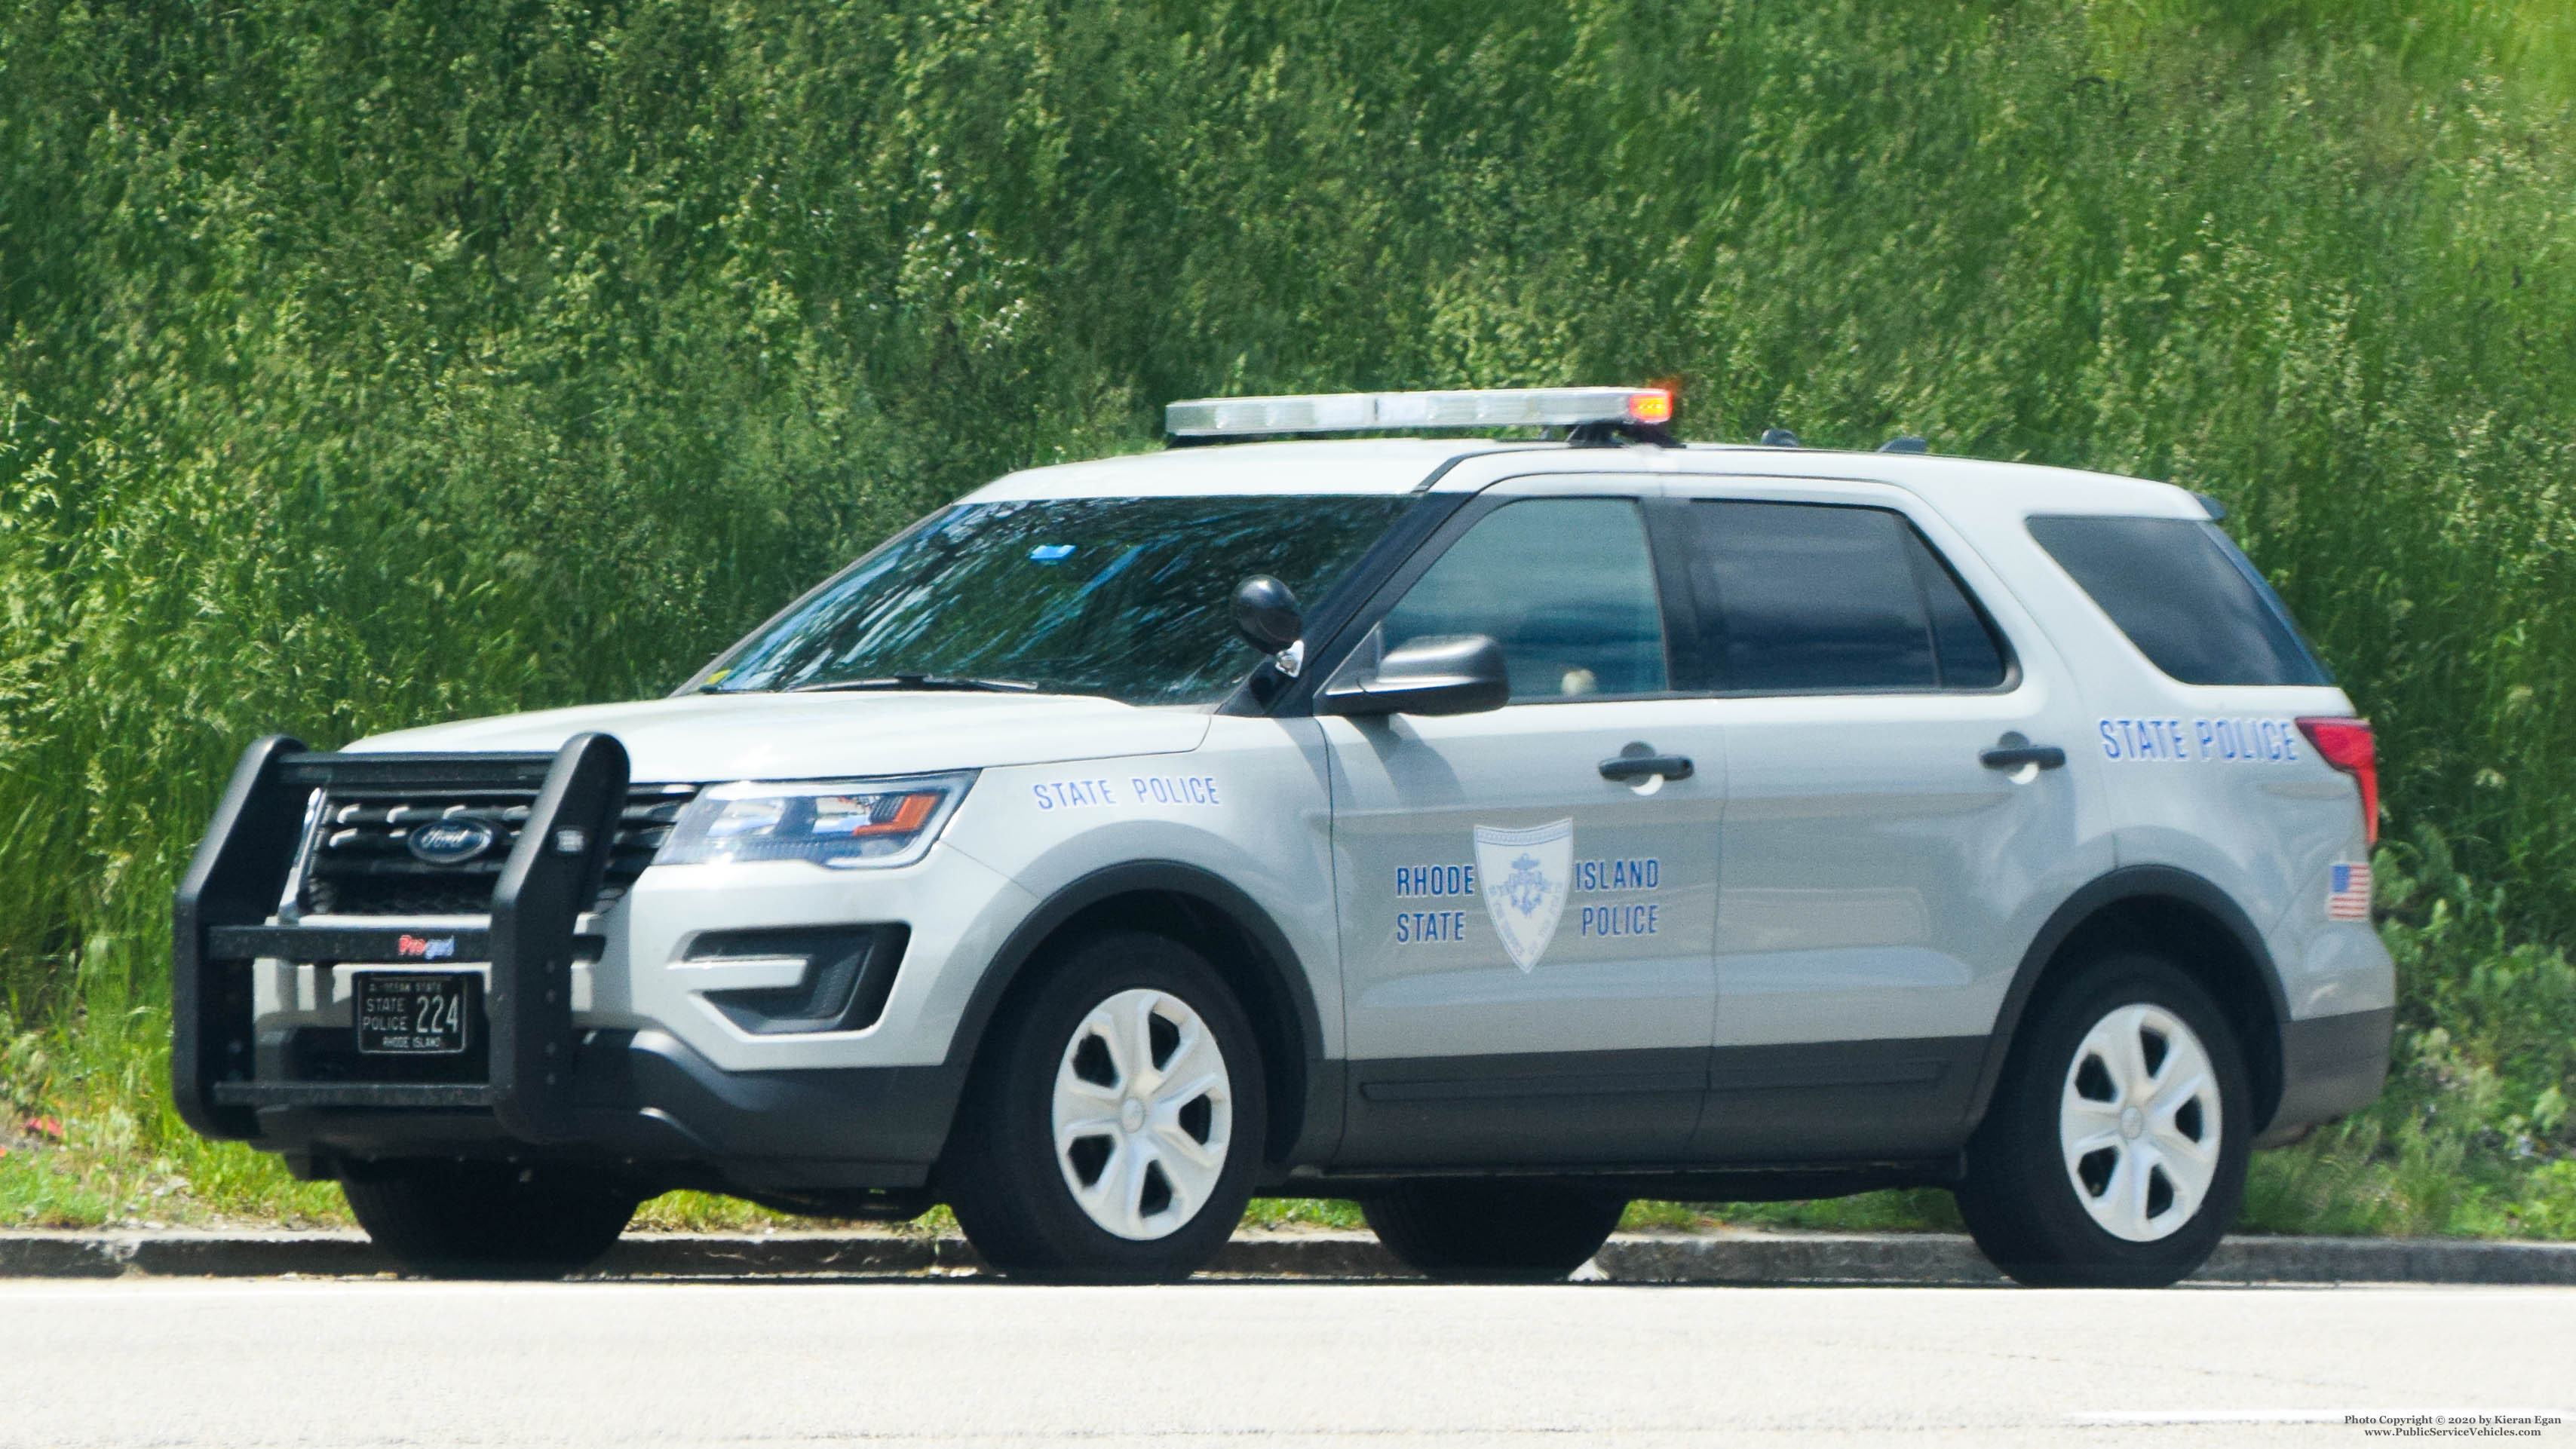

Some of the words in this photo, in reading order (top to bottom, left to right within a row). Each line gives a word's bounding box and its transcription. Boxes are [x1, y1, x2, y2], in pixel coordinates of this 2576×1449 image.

[2099, 718, 2188, 760] STATE
[2194, 718, 2298, 761] POLICE
[1033, 779, 1117, 810] STATE
[1131, 776, 1220, 805] POLICE
[421, 829, 469, 848] Ford
[1396, 865, 1475, 897] RHODE
[1575, 858, 1660, 892] ISLAND
[1396, 911, 1465, 942] STATE
[1582, 905, 1659, 936] POLICE
[366, 997, 405, 1012] STATE
[416, 994, 459, 1033] 224
[362, 1016, 408, 1031] POLICE
[382, 1037, 409, 1048] RHODE
[412, 1037, 441, 1048] ISLAND
